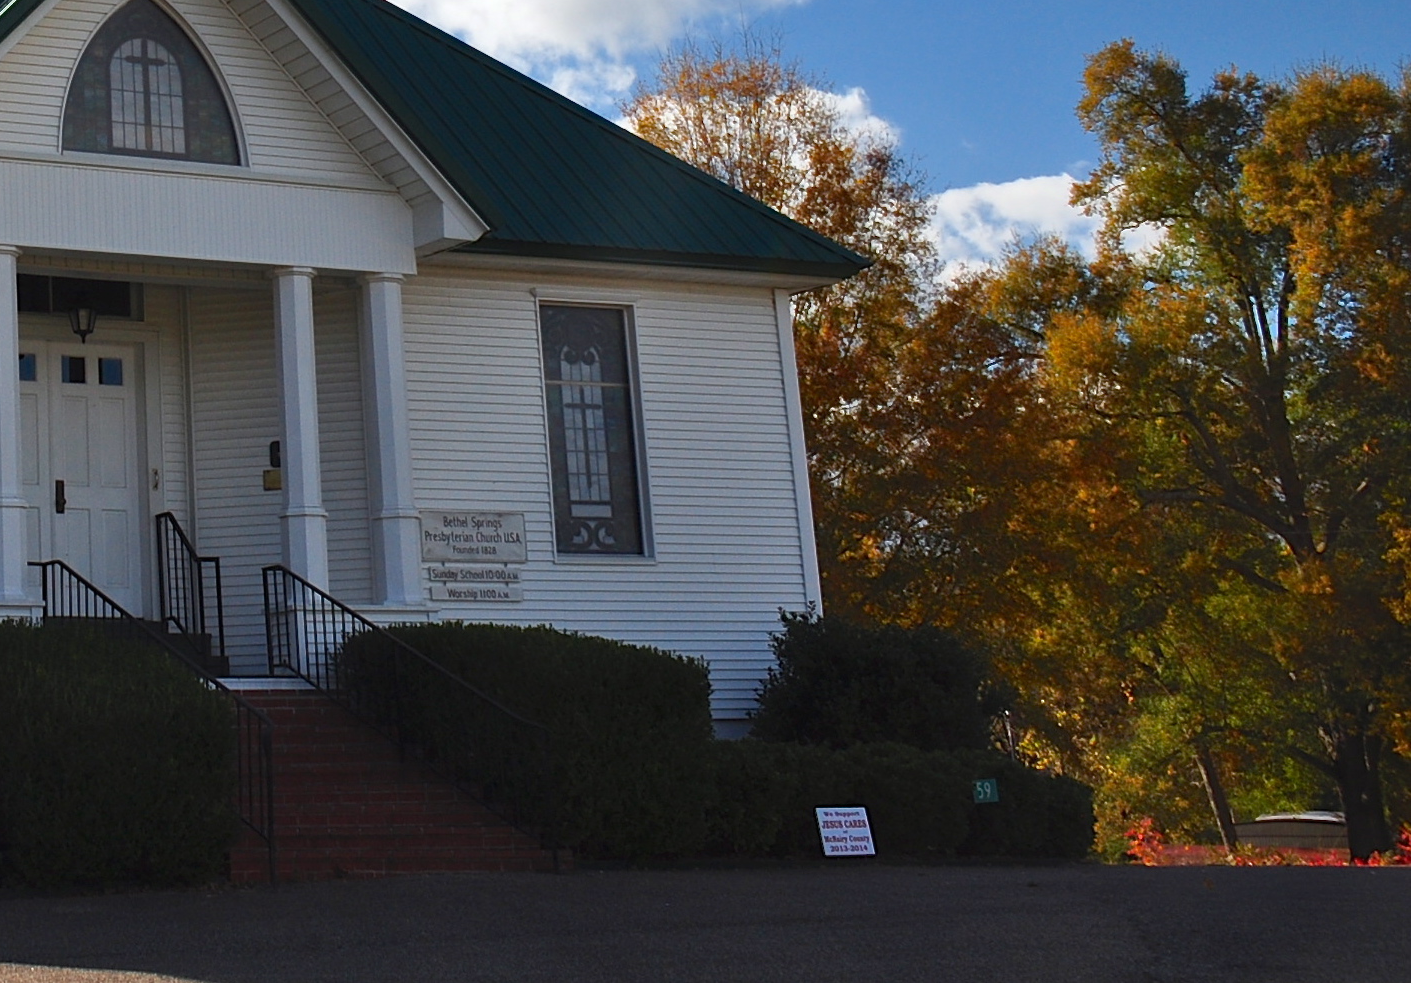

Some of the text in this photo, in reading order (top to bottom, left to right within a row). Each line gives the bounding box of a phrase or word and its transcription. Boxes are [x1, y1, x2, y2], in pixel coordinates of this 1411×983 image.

[443, 516, 502, 531] Bethel Springs
[425, 530, 522, 546] Presbyterian Church USA
[432, 568, 458, 580] Sunday
[460, 570, 484, 579] School
[447, 589, 477, 600] Worship
[976, 782, 991, 799] 59
[844, 820, 866, 828] CARES
